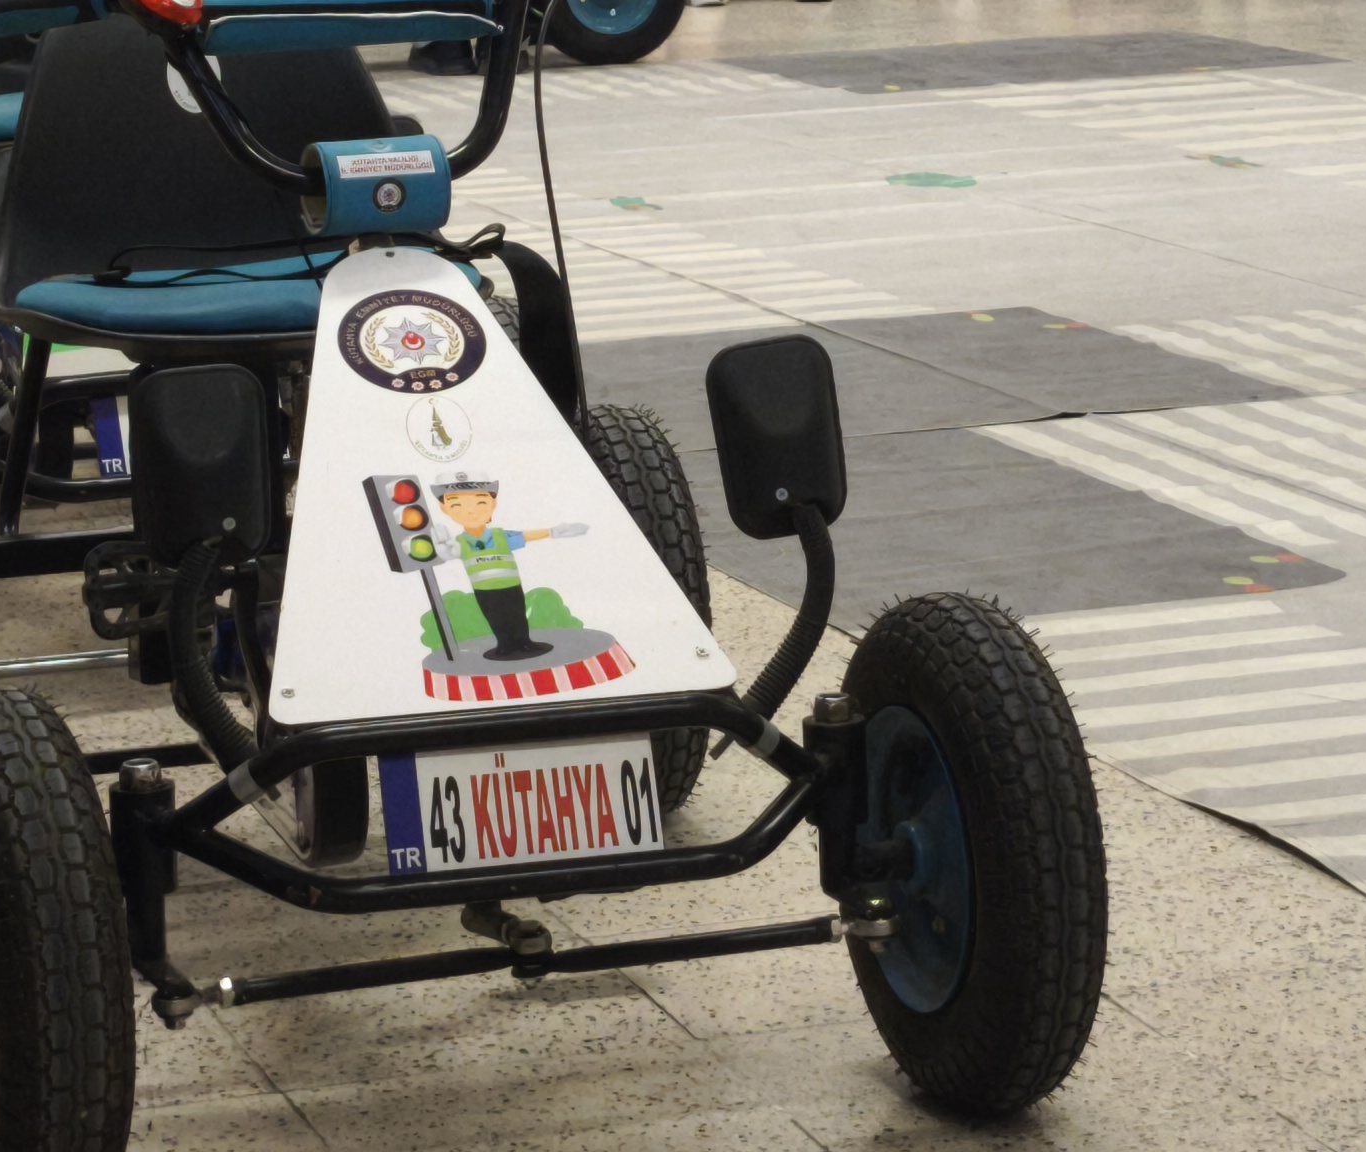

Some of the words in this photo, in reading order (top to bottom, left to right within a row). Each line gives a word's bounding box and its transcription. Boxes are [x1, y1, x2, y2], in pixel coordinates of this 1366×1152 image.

[101, 458, 124, 473] TR
[430, 775, 466, 863] 43
[470, 753, 620, 859] KÜTAHYA
[621, 758, 659, 845] 01
[391, 847, 422, 870] TR
